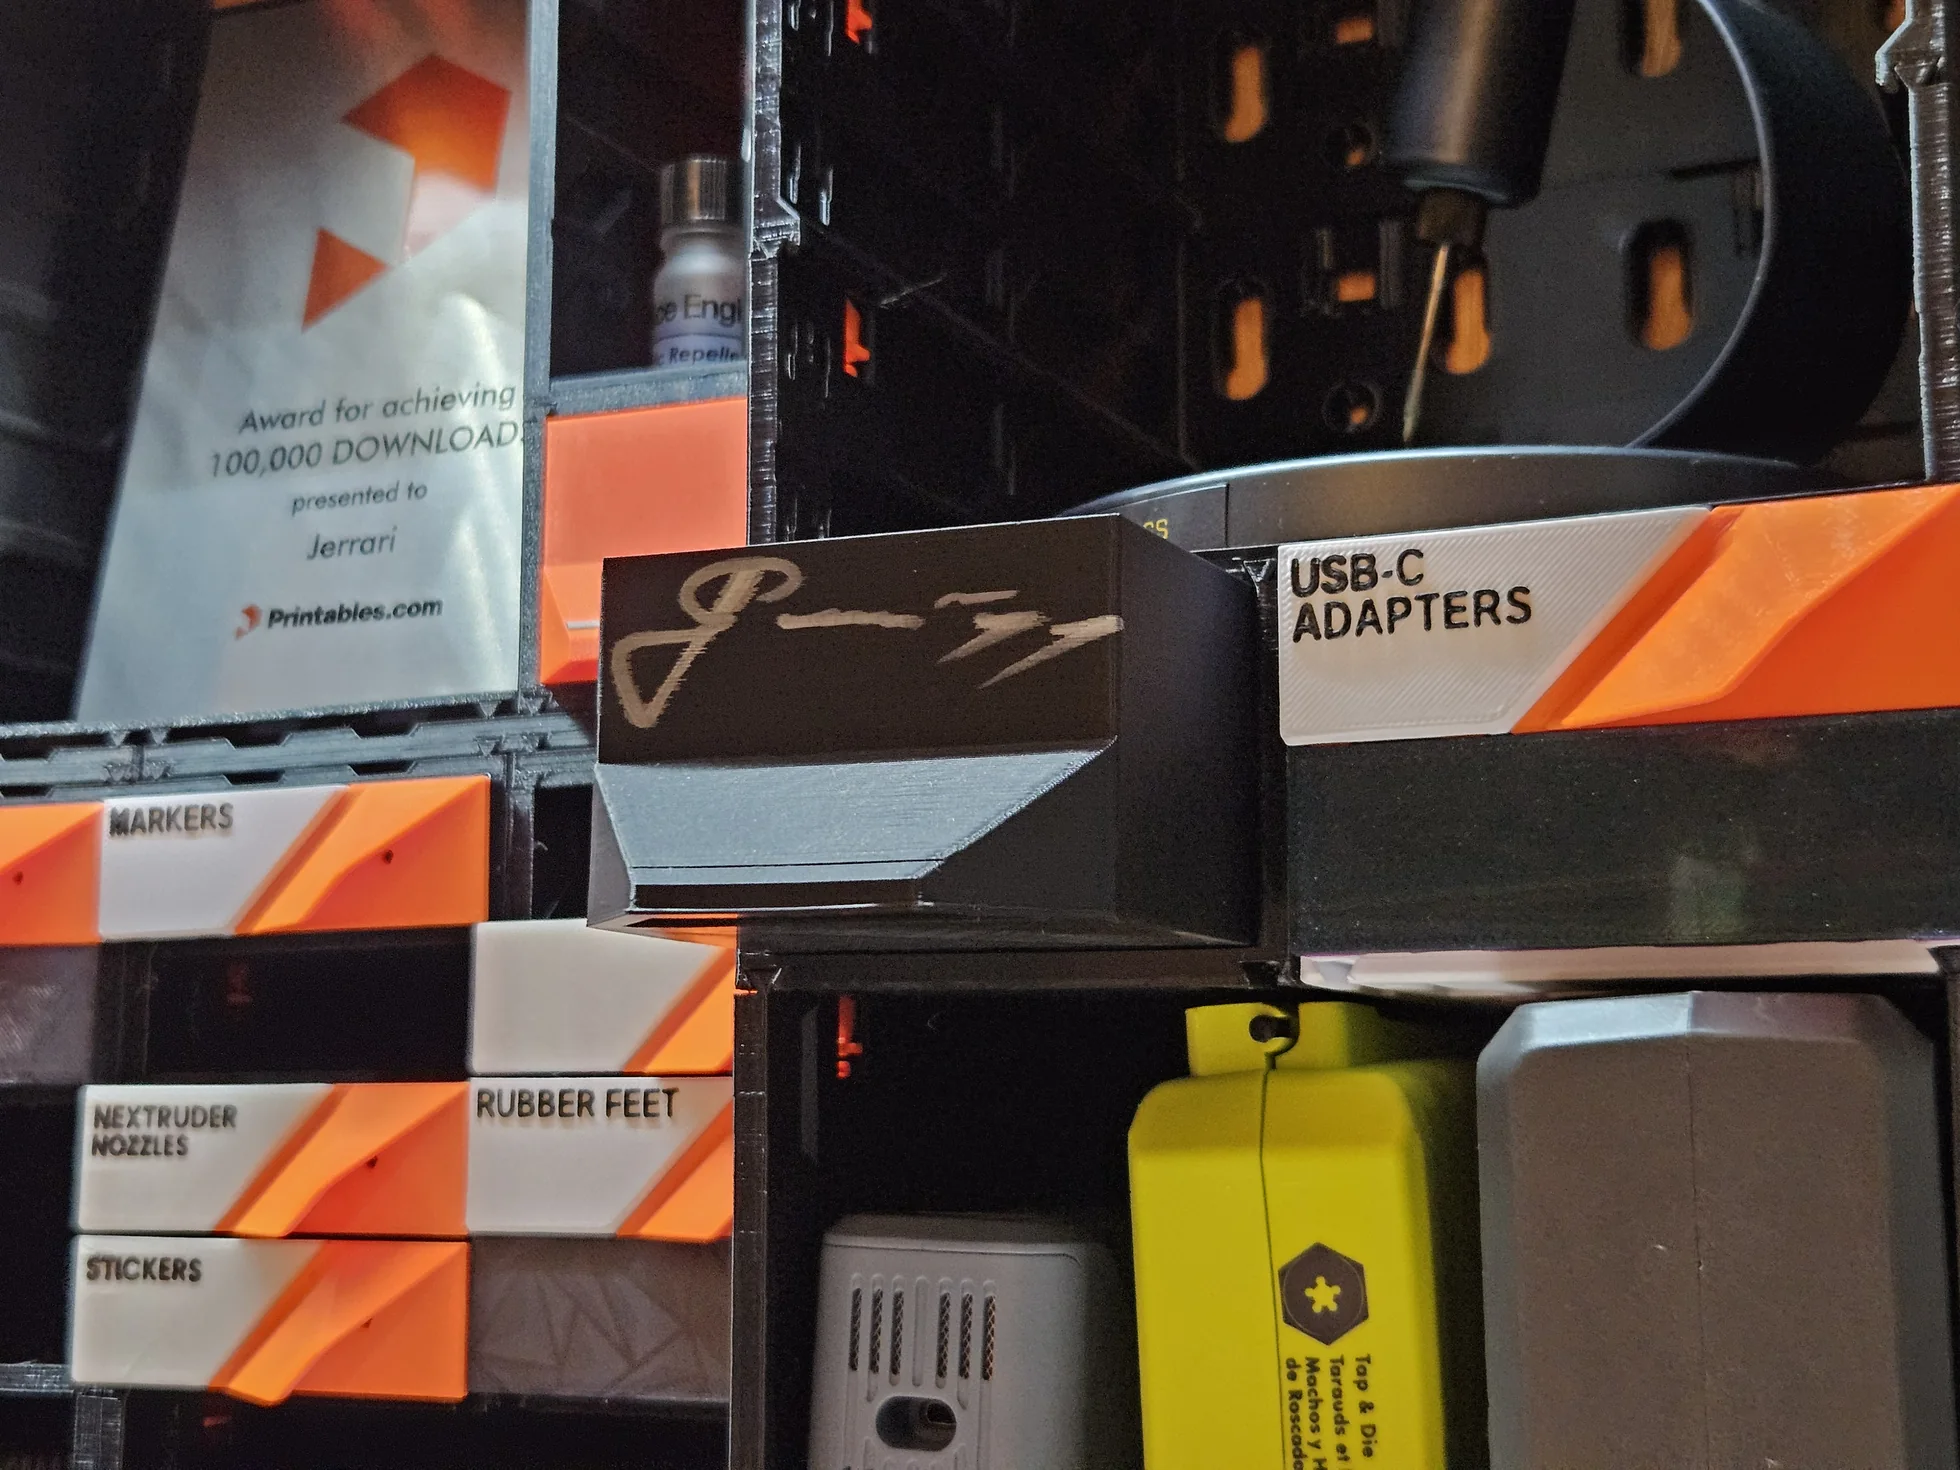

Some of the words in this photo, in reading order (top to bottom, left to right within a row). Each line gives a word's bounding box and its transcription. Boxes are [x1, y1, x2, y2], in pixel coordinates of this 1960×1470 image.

[238, 401, 326, 434] Award
[336, 400, 370, 423] for
[382, 384, 516, 419] achieving
[211, 442, 323, 478] 100,000
[332, 420, 524, 466] DOWNLOAD
[291, 481, 400, 516] presented
[407, 481, 428, 501] to
[306, 526, 398, 561] Jerrari
[1290, 549, 1424, 597] USB-C
[267, 598, 444, 629] Printables.com
[1293, 586, 1532, 643] ADAPTERS
[109, 802, 234, 836] MARKERS
[93, 1103, 237, 1129] NEXTRUDER
[476, 1087, 595, 1118] RUBBER
[605, 1087, 680, 1118] FEET
[91, 1133, 190, 1157] NOZZLES
[86, 1255, 202, 1282] STICKERS
[1286, 1357, 1302, 1381] de
[1353, 1353, 1371, 1391] Tap
[1305, 1356, 1324, 1434] Machos
[1329, 1353, 1350, 1436] Tarauds
[1358, 1400, 1375, 1414] &
[1288, 1389, 1308, 1470] Roscado
[1306, 1439, 1321, 1450] y
[1360, 1423, 1378, 1458] Die
[1335, 1443, 1351, 1461] et
